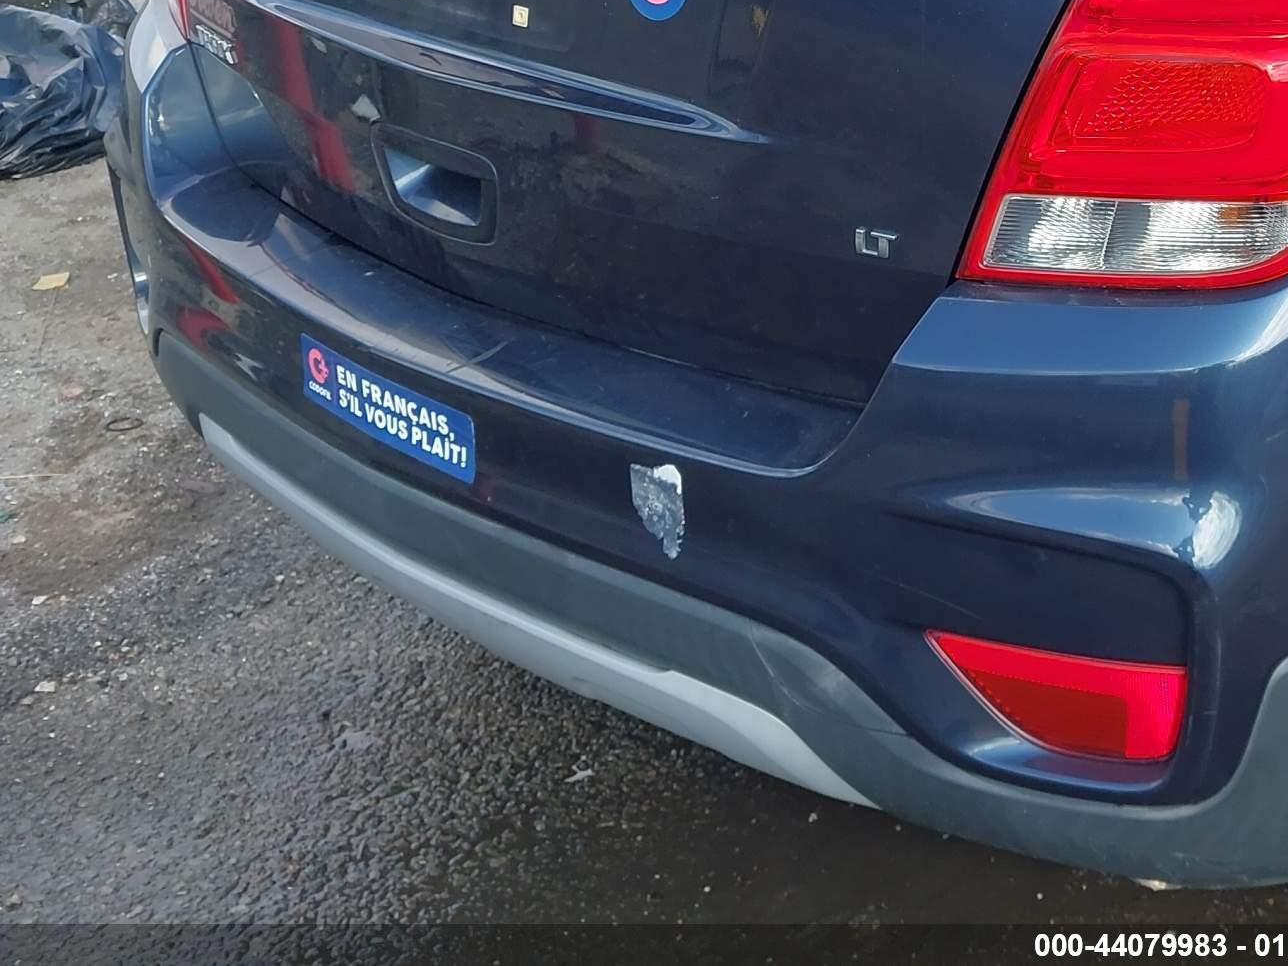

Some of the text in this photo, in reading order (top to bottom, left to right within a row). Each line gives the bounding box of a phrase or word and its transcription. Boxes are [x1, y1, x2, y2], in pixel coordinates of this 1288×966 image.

[855, 226, 899, 259] LT
[336, 365, 455, 442] EN FRANÇAIS,
[338, 389, 363, 418] S'IL
[364, 403, 408, 440] VOUS
